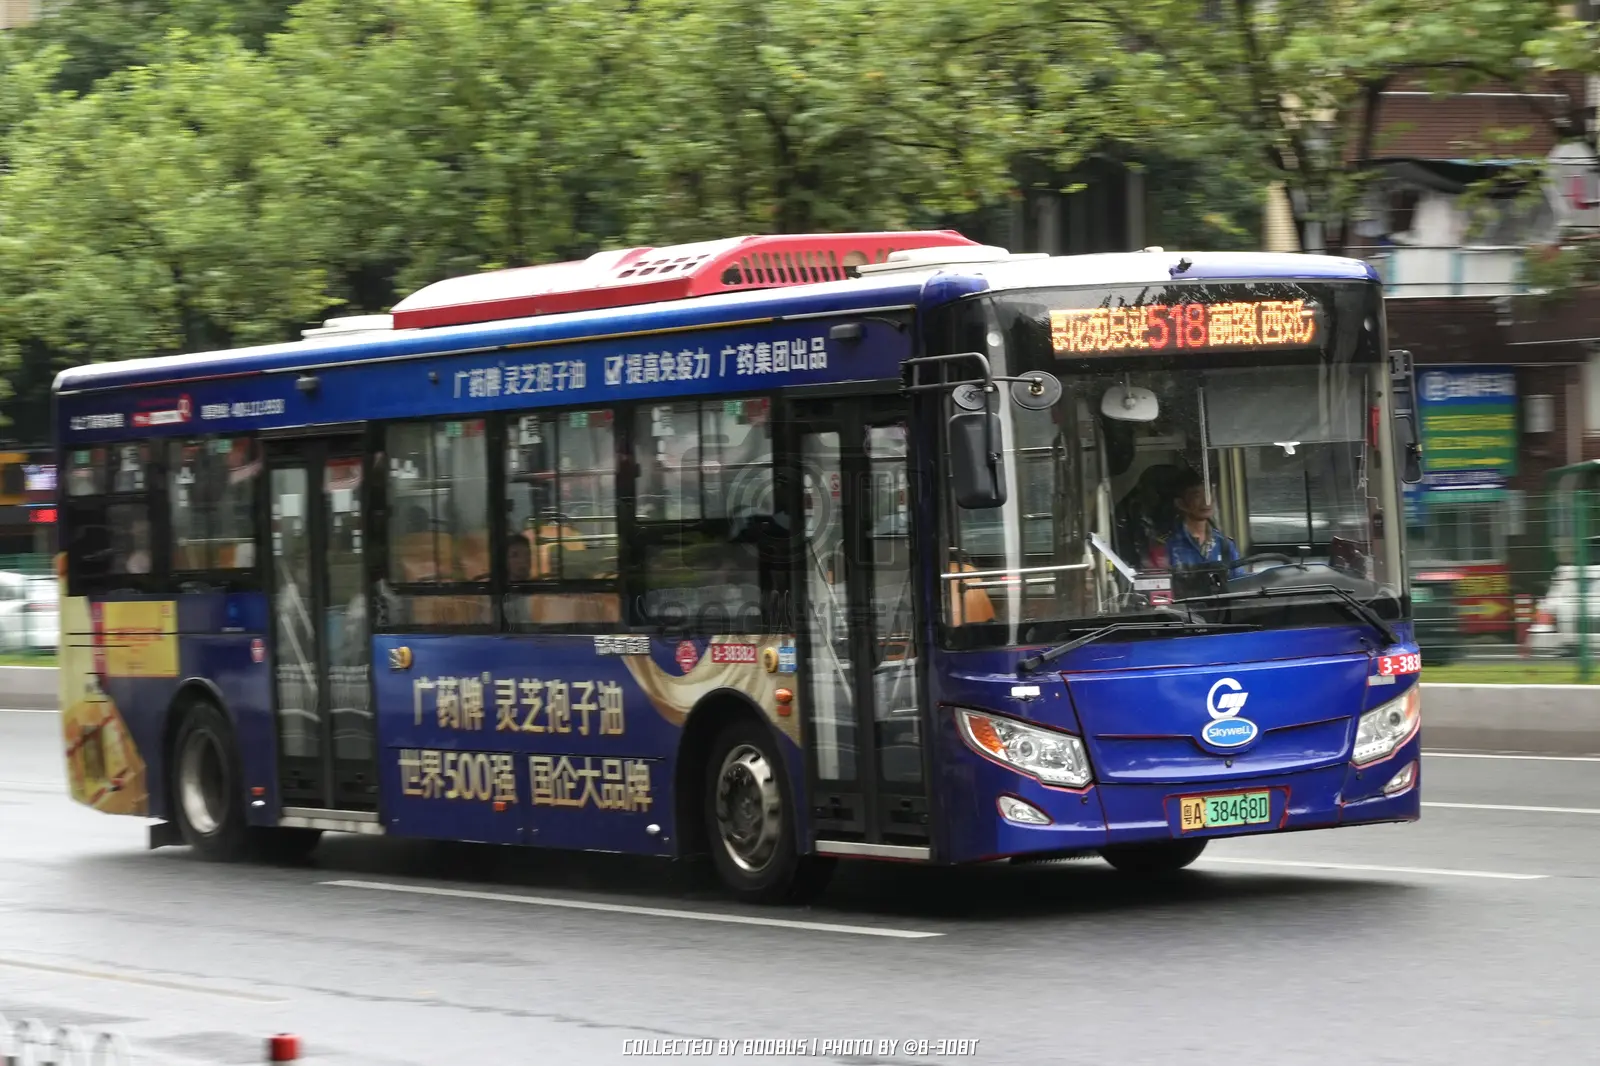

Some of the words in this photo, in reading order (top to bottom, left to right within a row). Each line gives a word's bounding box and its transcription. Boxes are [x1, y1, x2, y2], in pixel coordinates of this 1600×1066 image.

[1147, 304, 1207, 349] 518
[626, 347, 711, 384] 提高免疫力
[719, 337, 828, 377] 广药集团出品
